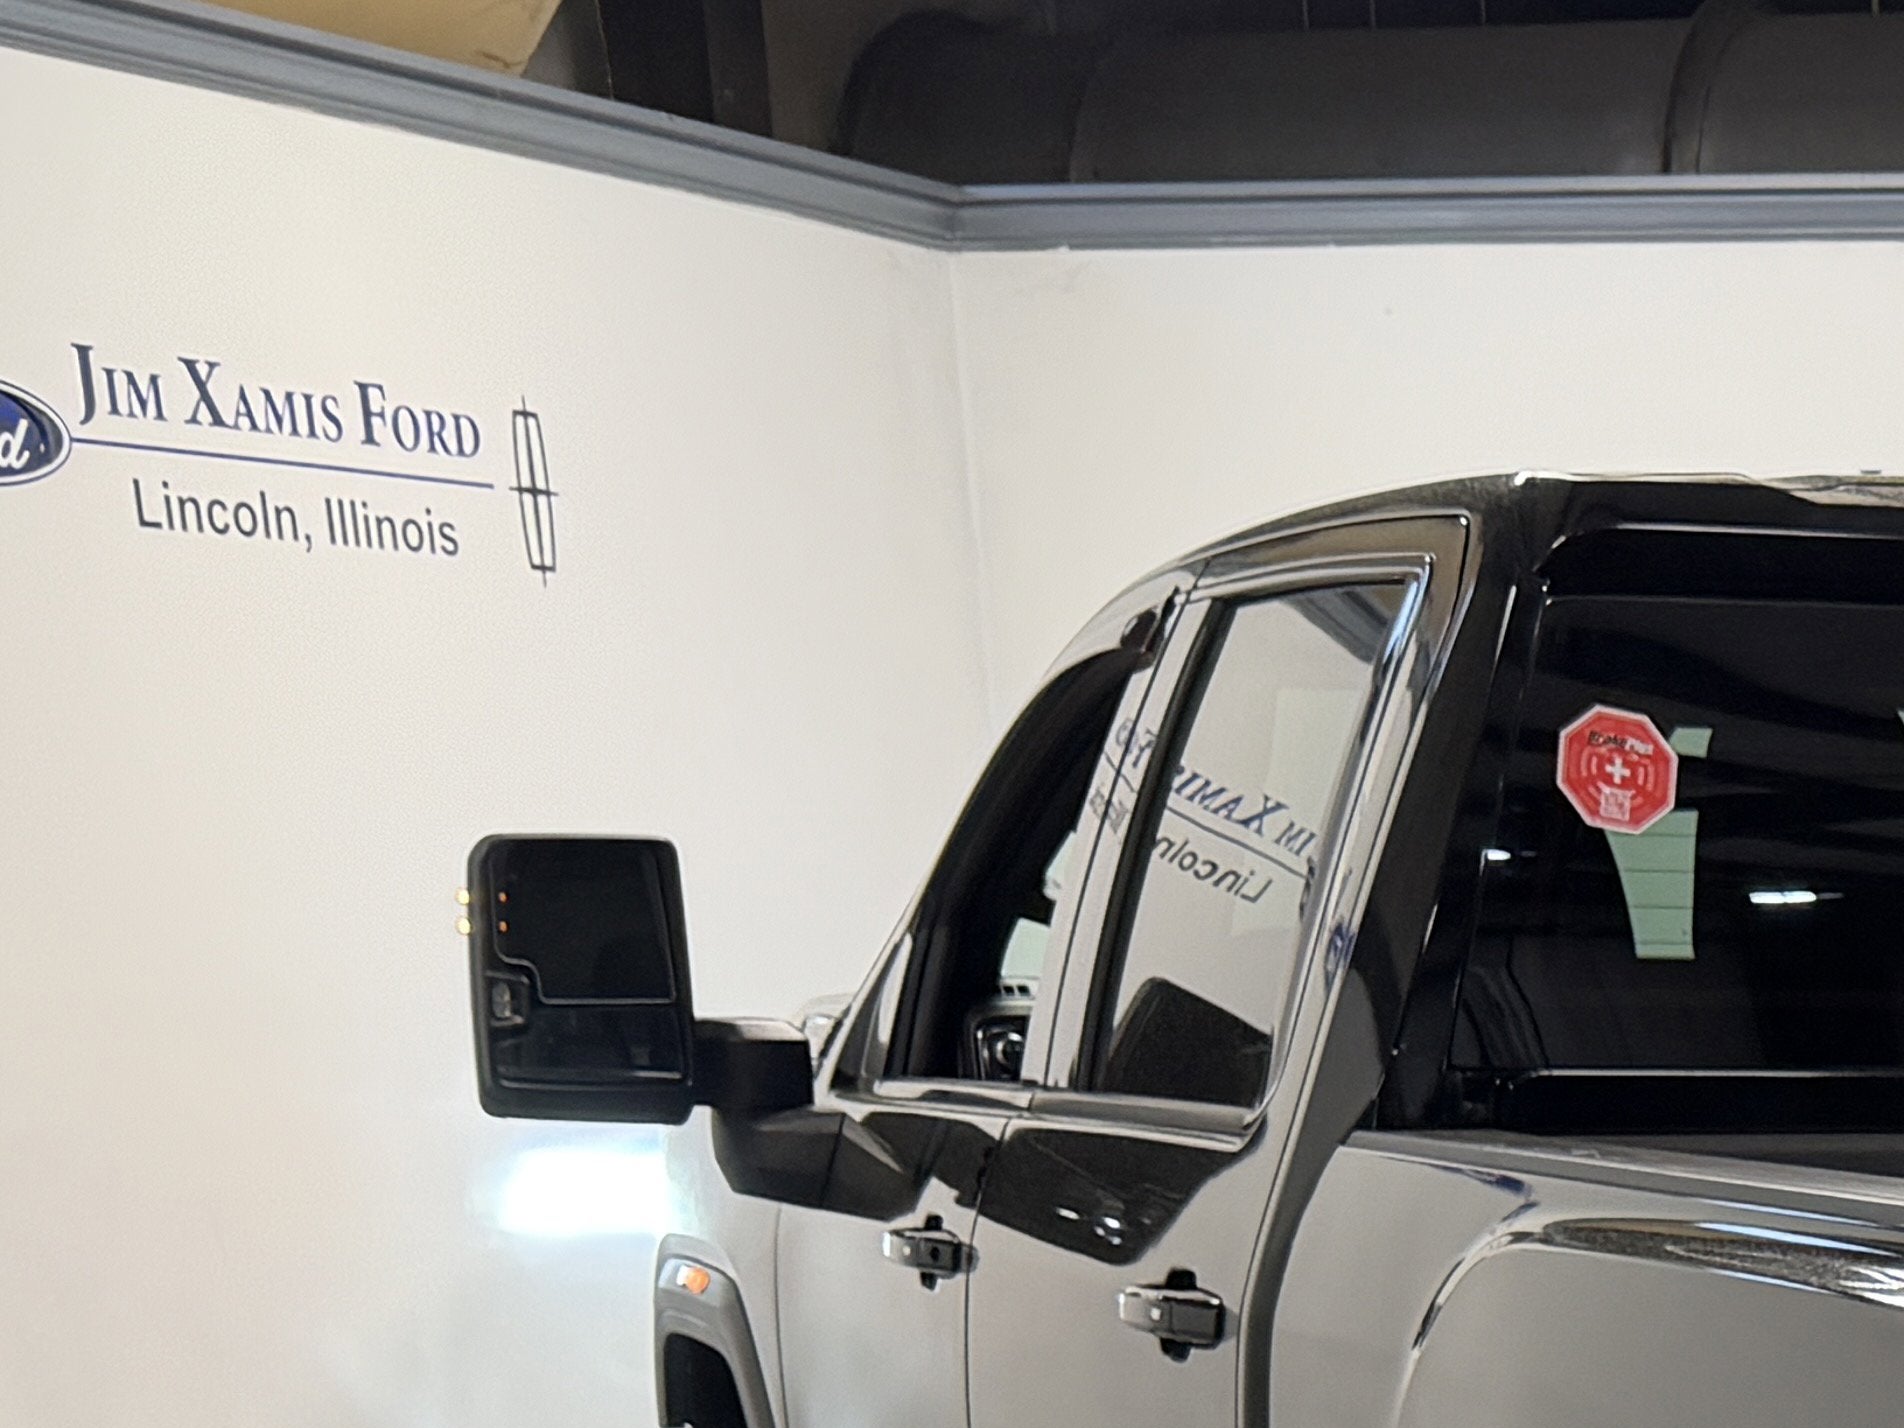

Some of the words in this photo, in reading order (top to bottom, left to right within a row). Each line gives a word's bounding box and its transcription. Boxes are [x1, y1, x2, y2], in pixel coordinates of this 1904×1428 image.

[70, 342, 168, 426] JIM
[178, 356, 344, 444] XAMIS
[353, 380, 481, 459] FORD
[133, 478, 314, 553] Lincoln,
[324, 496, 460, 556] Illinois
